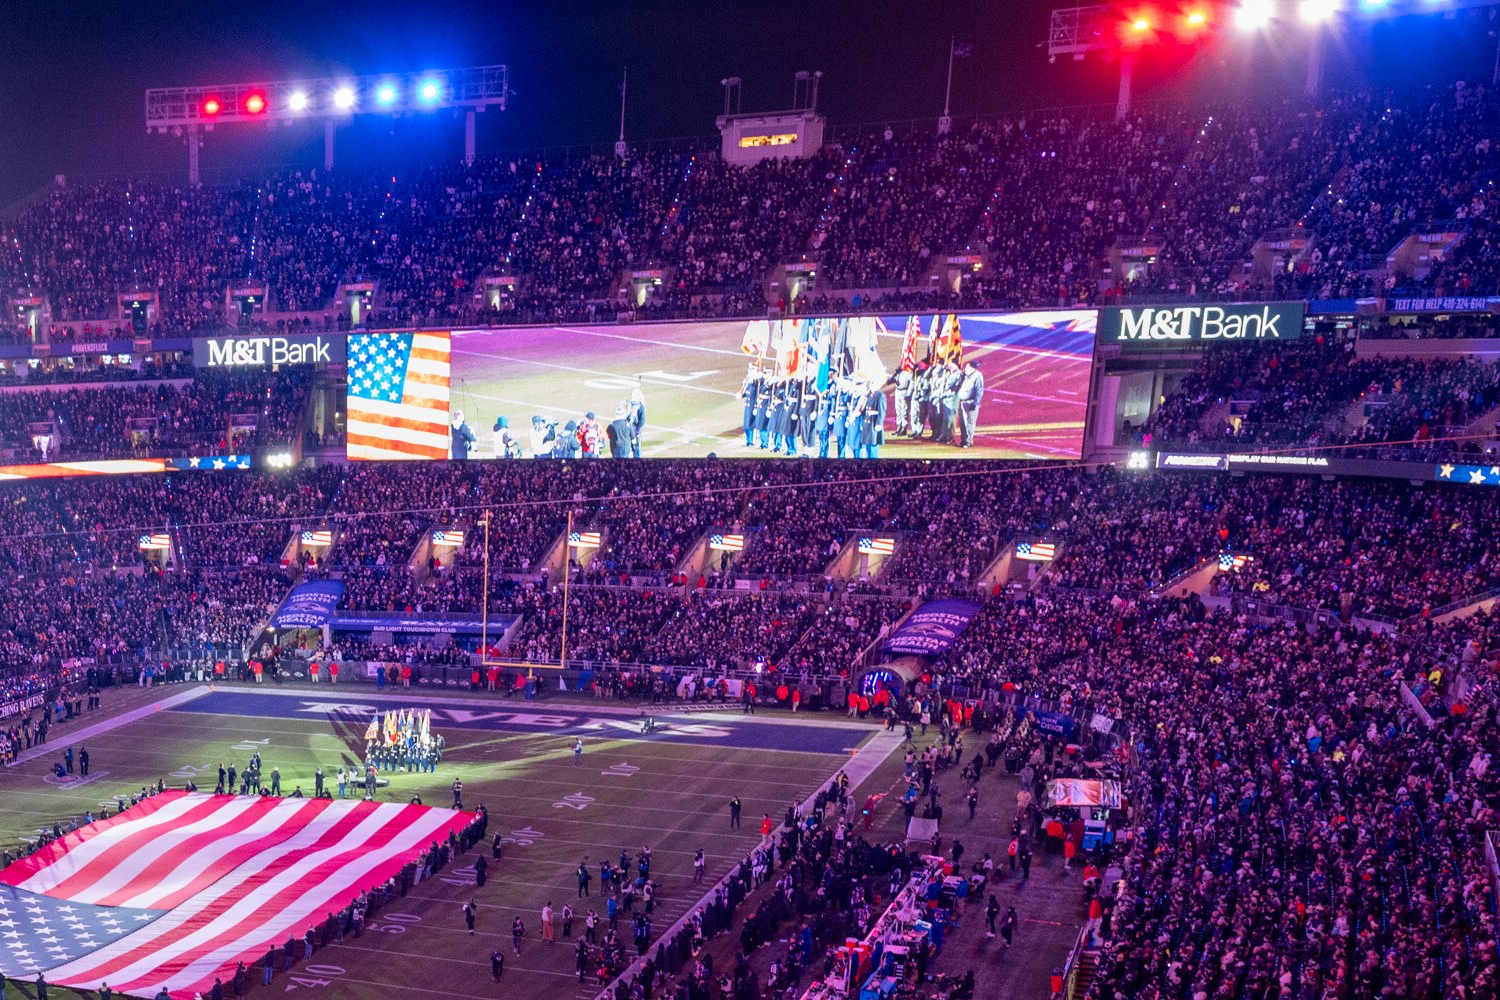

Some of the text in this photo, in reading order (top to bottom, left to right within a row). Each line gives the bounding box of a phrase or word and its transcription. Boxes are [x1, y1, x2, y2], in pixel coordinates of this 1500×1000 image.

[1395, 300, 1410, 311] TEXT
[1412, 300, 1425, 310] FOR
[1426, 299, 1442, 310] HELP
[1117, 306, 1281, 340] M&T Bank
[207, 337, 330, 365] M&T Bank
